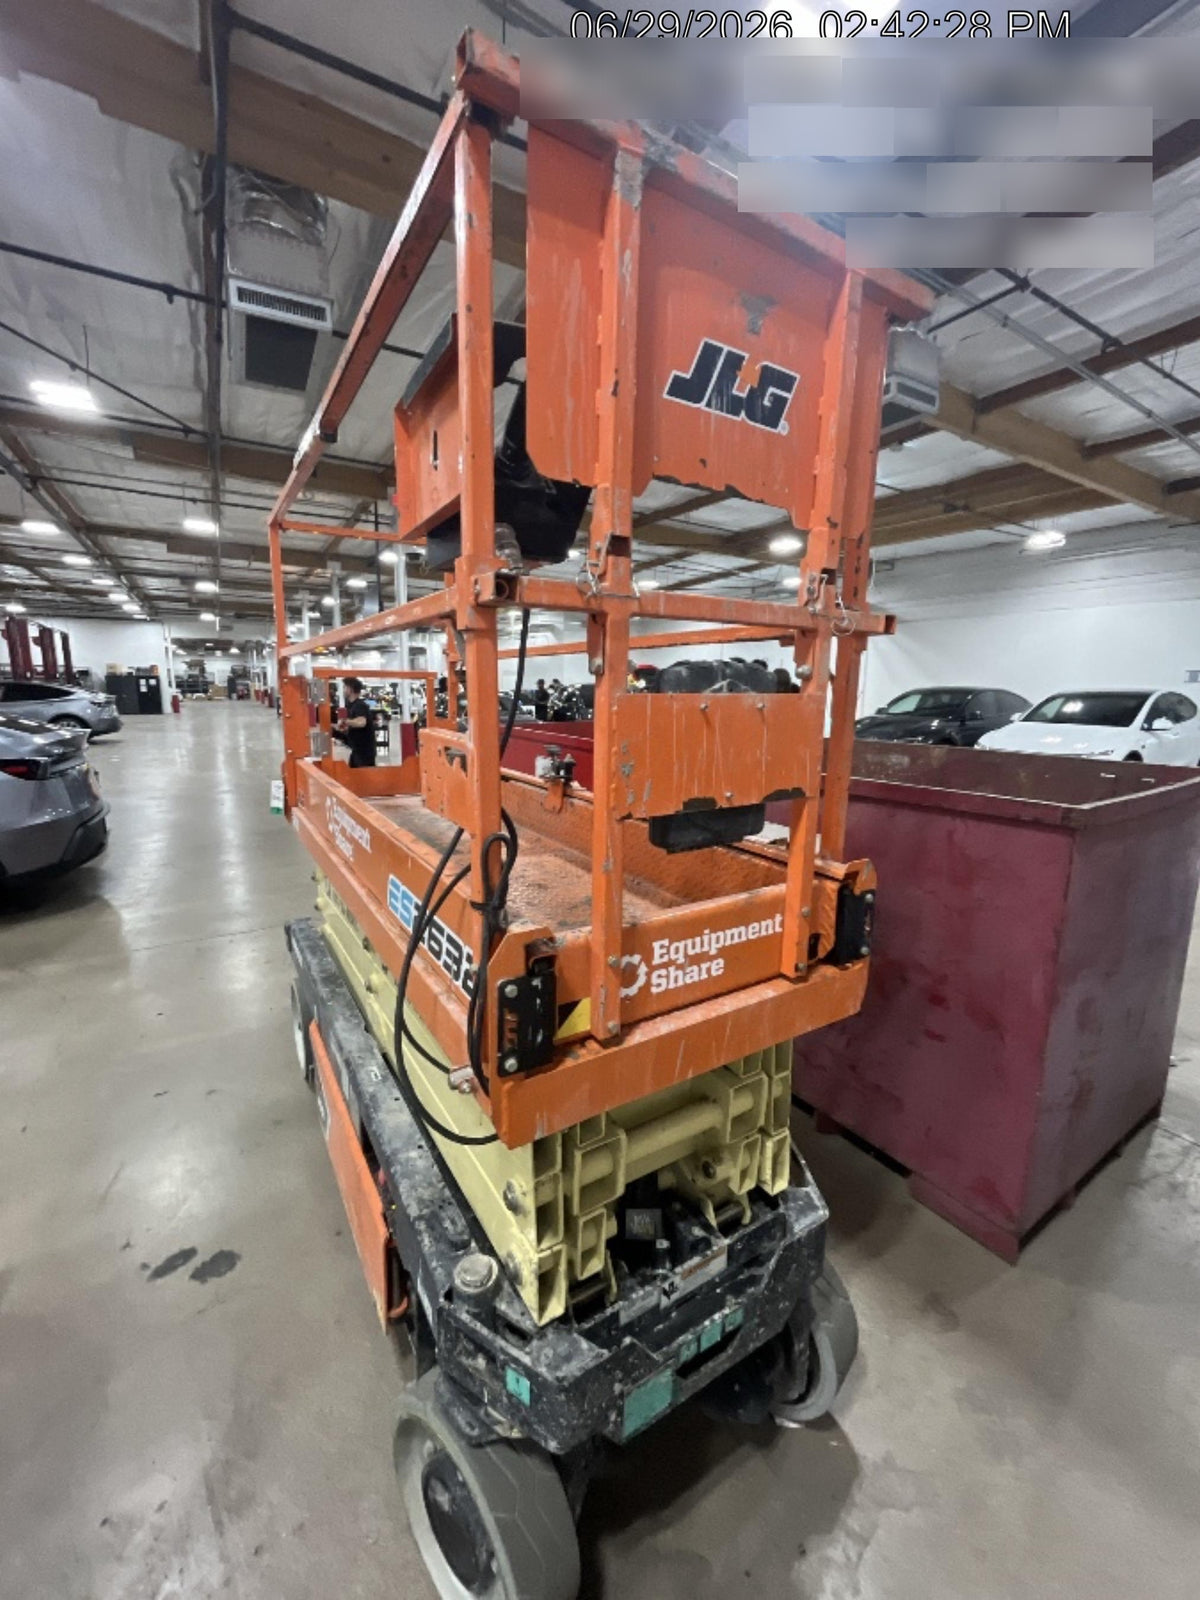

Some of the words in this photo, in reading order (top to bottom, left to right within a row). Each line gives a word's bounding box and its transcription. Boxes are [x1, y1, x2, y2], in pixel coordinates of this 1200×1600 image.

[663, 337, 800, 433] JLG
[652, 913, 783, 964] Equipment
[650, 957, 725, 993] Share
